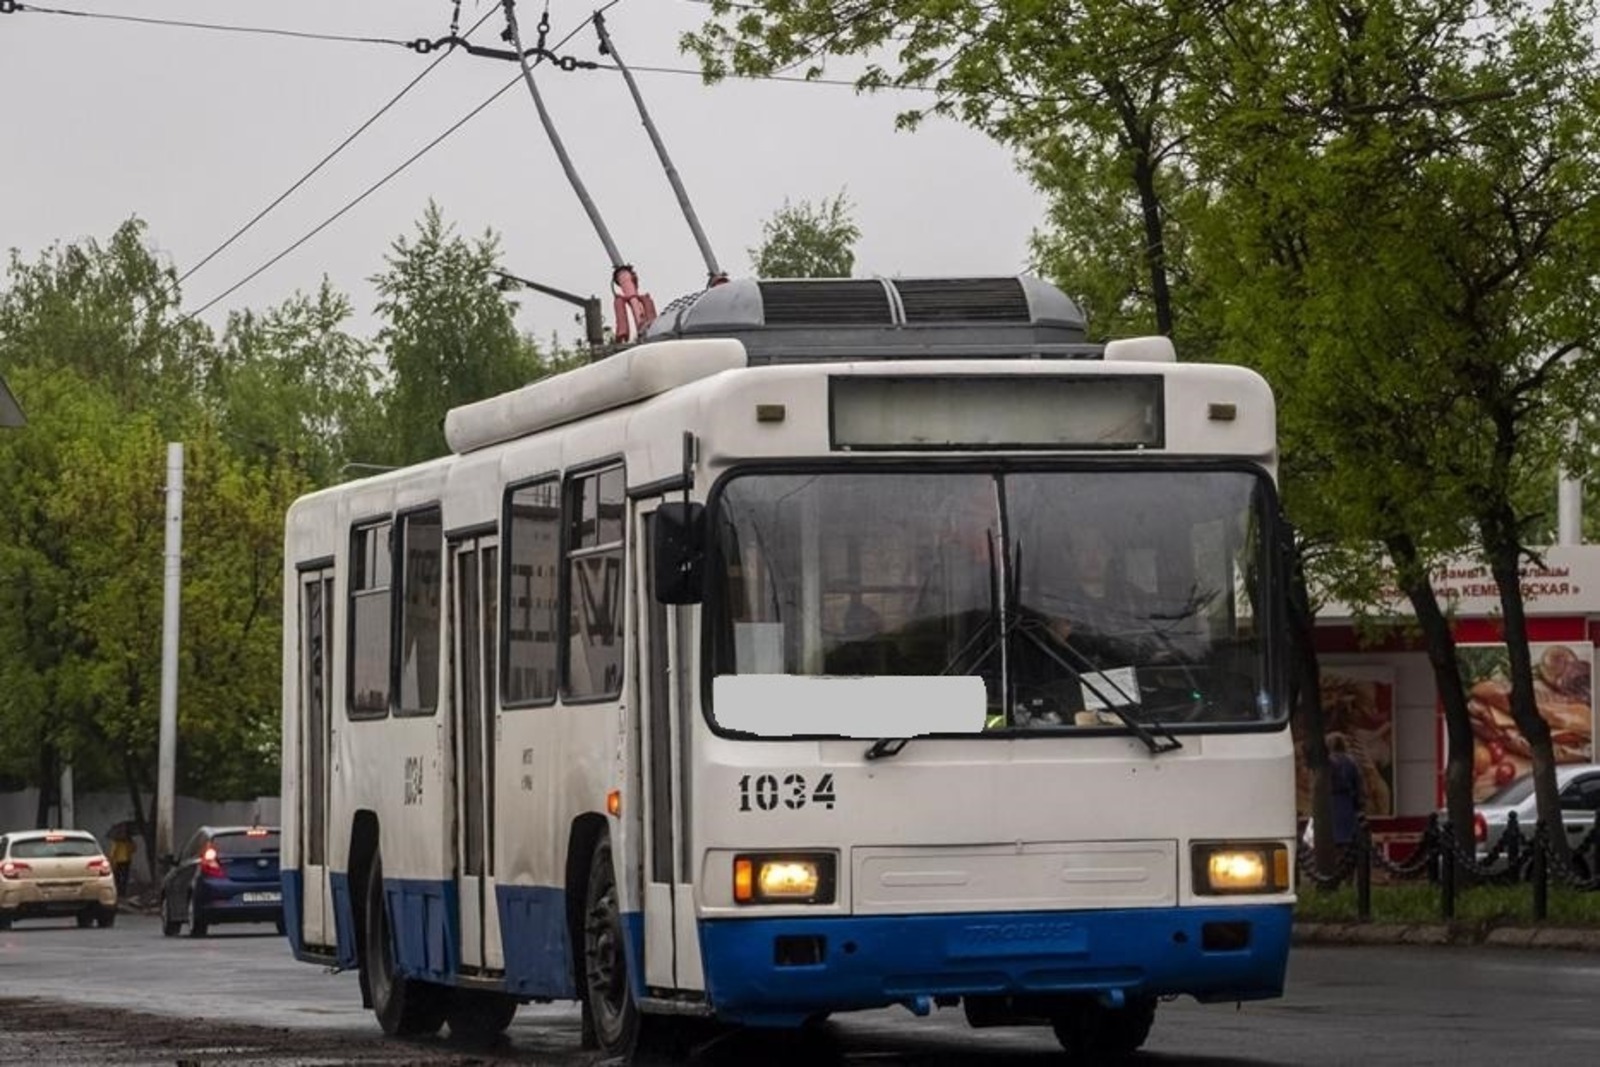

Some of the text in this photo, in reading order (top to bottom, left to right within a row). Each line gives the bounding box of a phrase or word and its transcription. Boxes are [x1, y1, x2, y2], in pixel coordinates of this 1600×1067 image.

[1463, 583, 1569, 597] КЕМЕВСКАЯ
[739, 773, 835, 811] 1034
[962, 922, 1073, 941] TROBUS
